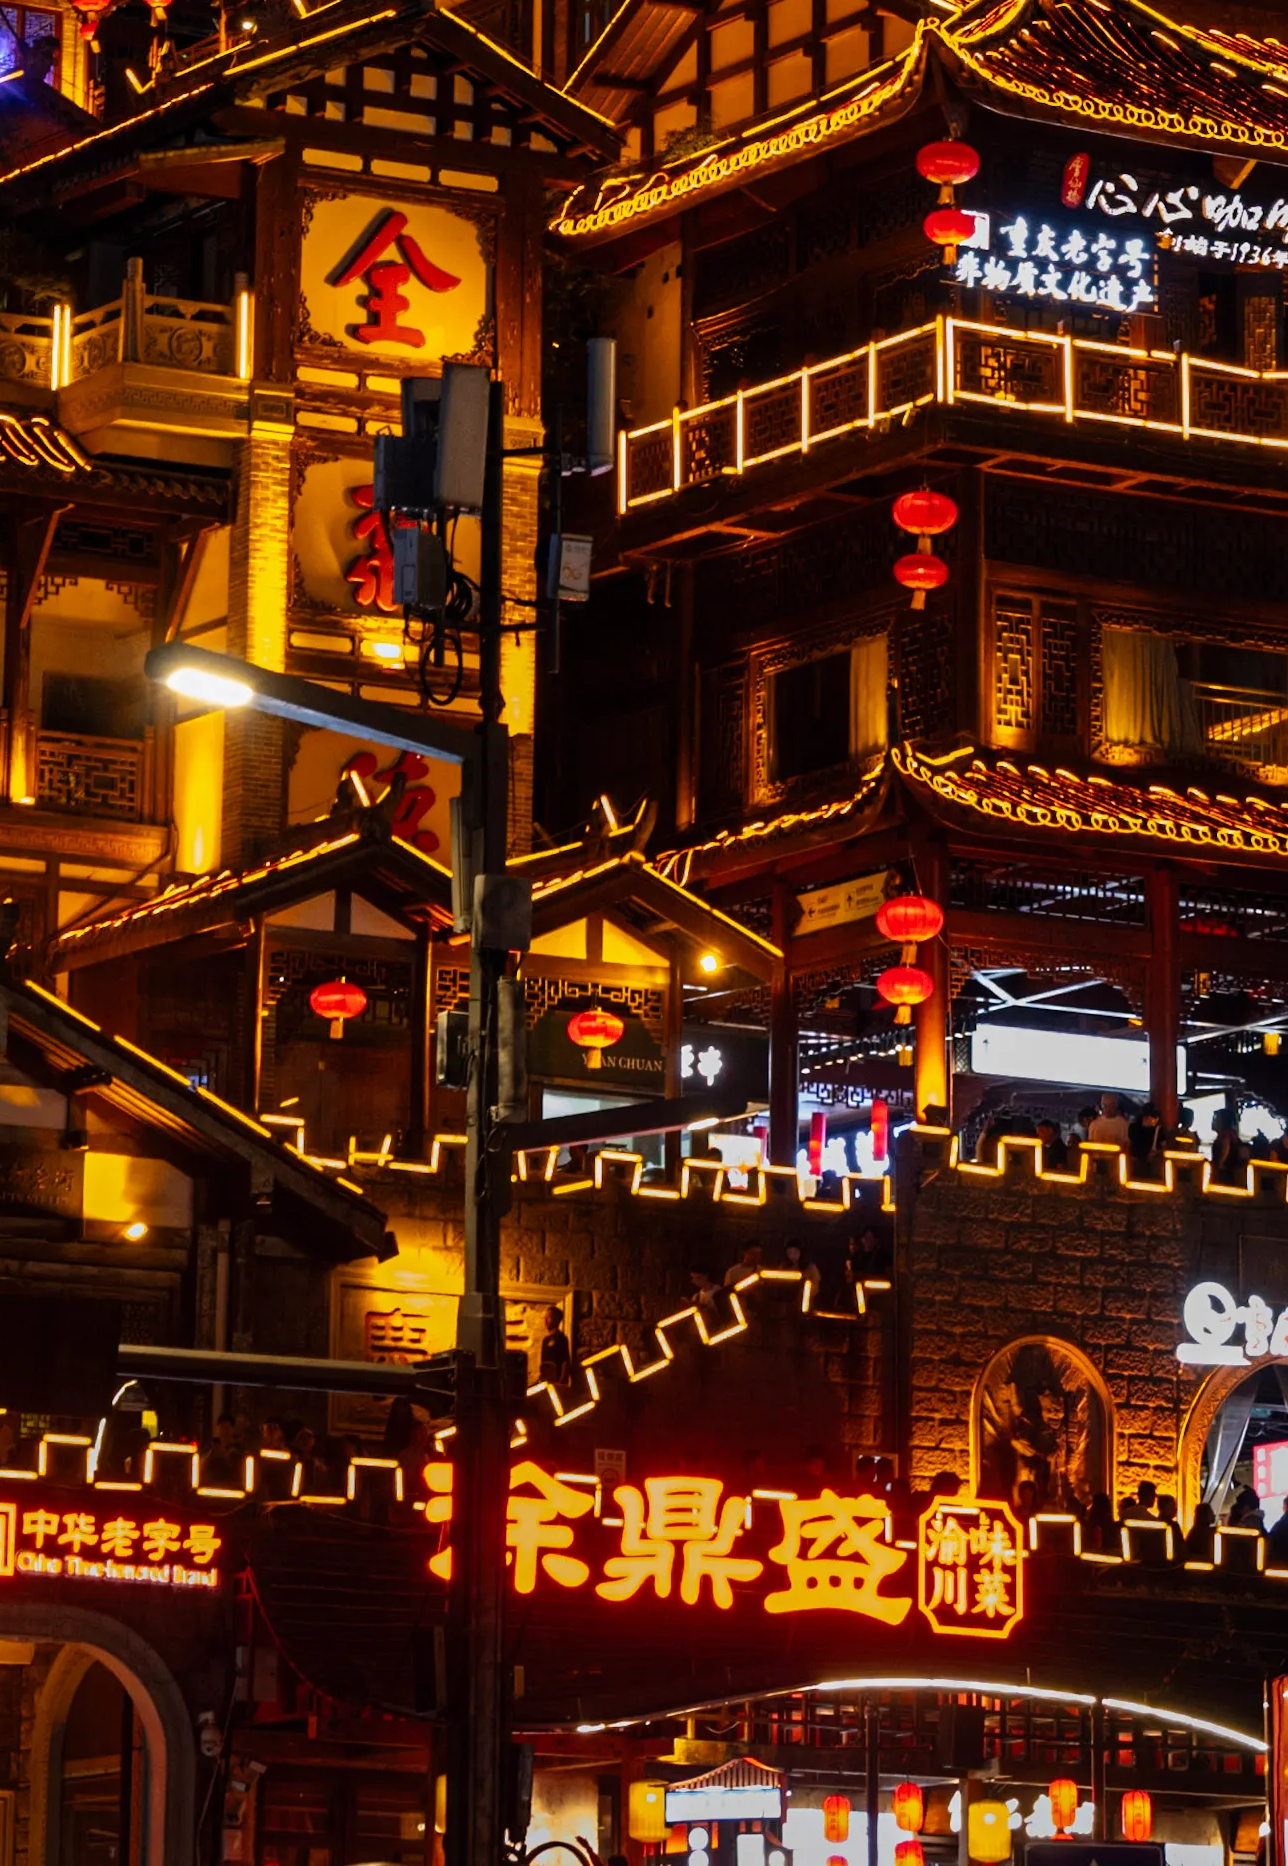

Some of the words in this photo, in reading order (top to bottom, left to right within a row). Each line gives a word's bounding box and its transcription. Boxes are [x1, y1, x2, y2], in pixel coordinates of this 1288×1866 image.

[1000, 216, 1152, 279] 重庆老字号
[22, 1508, 222, 1564] 中华老字号
[926, 1567, 1016, 1619] 川菜
